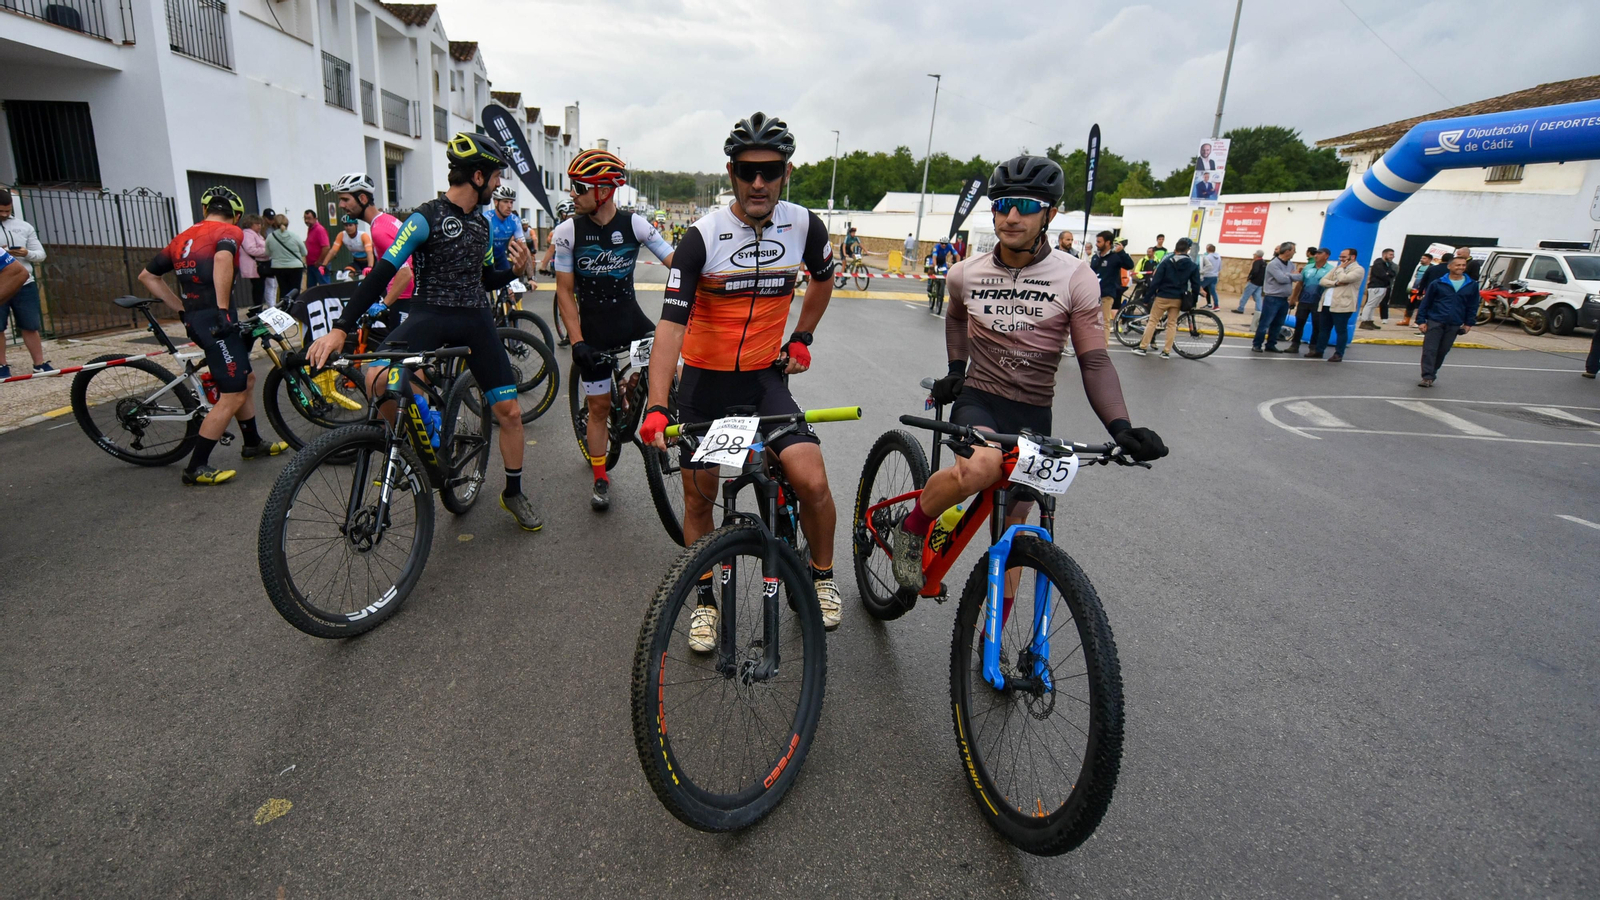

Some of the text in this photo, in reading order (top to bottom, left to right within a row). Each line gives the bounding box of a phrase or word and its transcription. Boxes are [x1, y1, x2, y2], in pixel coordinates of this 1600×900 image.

[1466, 124, 1529, 139] Diputación
[1465, 139, 1514, 152] de Cádiz
[388, 220, 417, 258] MAVIC
[738, 249, 778, 260] SYMISUR
[1023, 278, 1053, 287] KAKUL
[970, 289, 1056, 303] HARMAN
[996, 305, 1044, 318] RUGUE
[408, 403, 439, 467] SCOTT
[702, 433, 745, 455] 198
[1022, 454, 1071, 482] 185
[960, 740, 983, 789] PIRELLI
